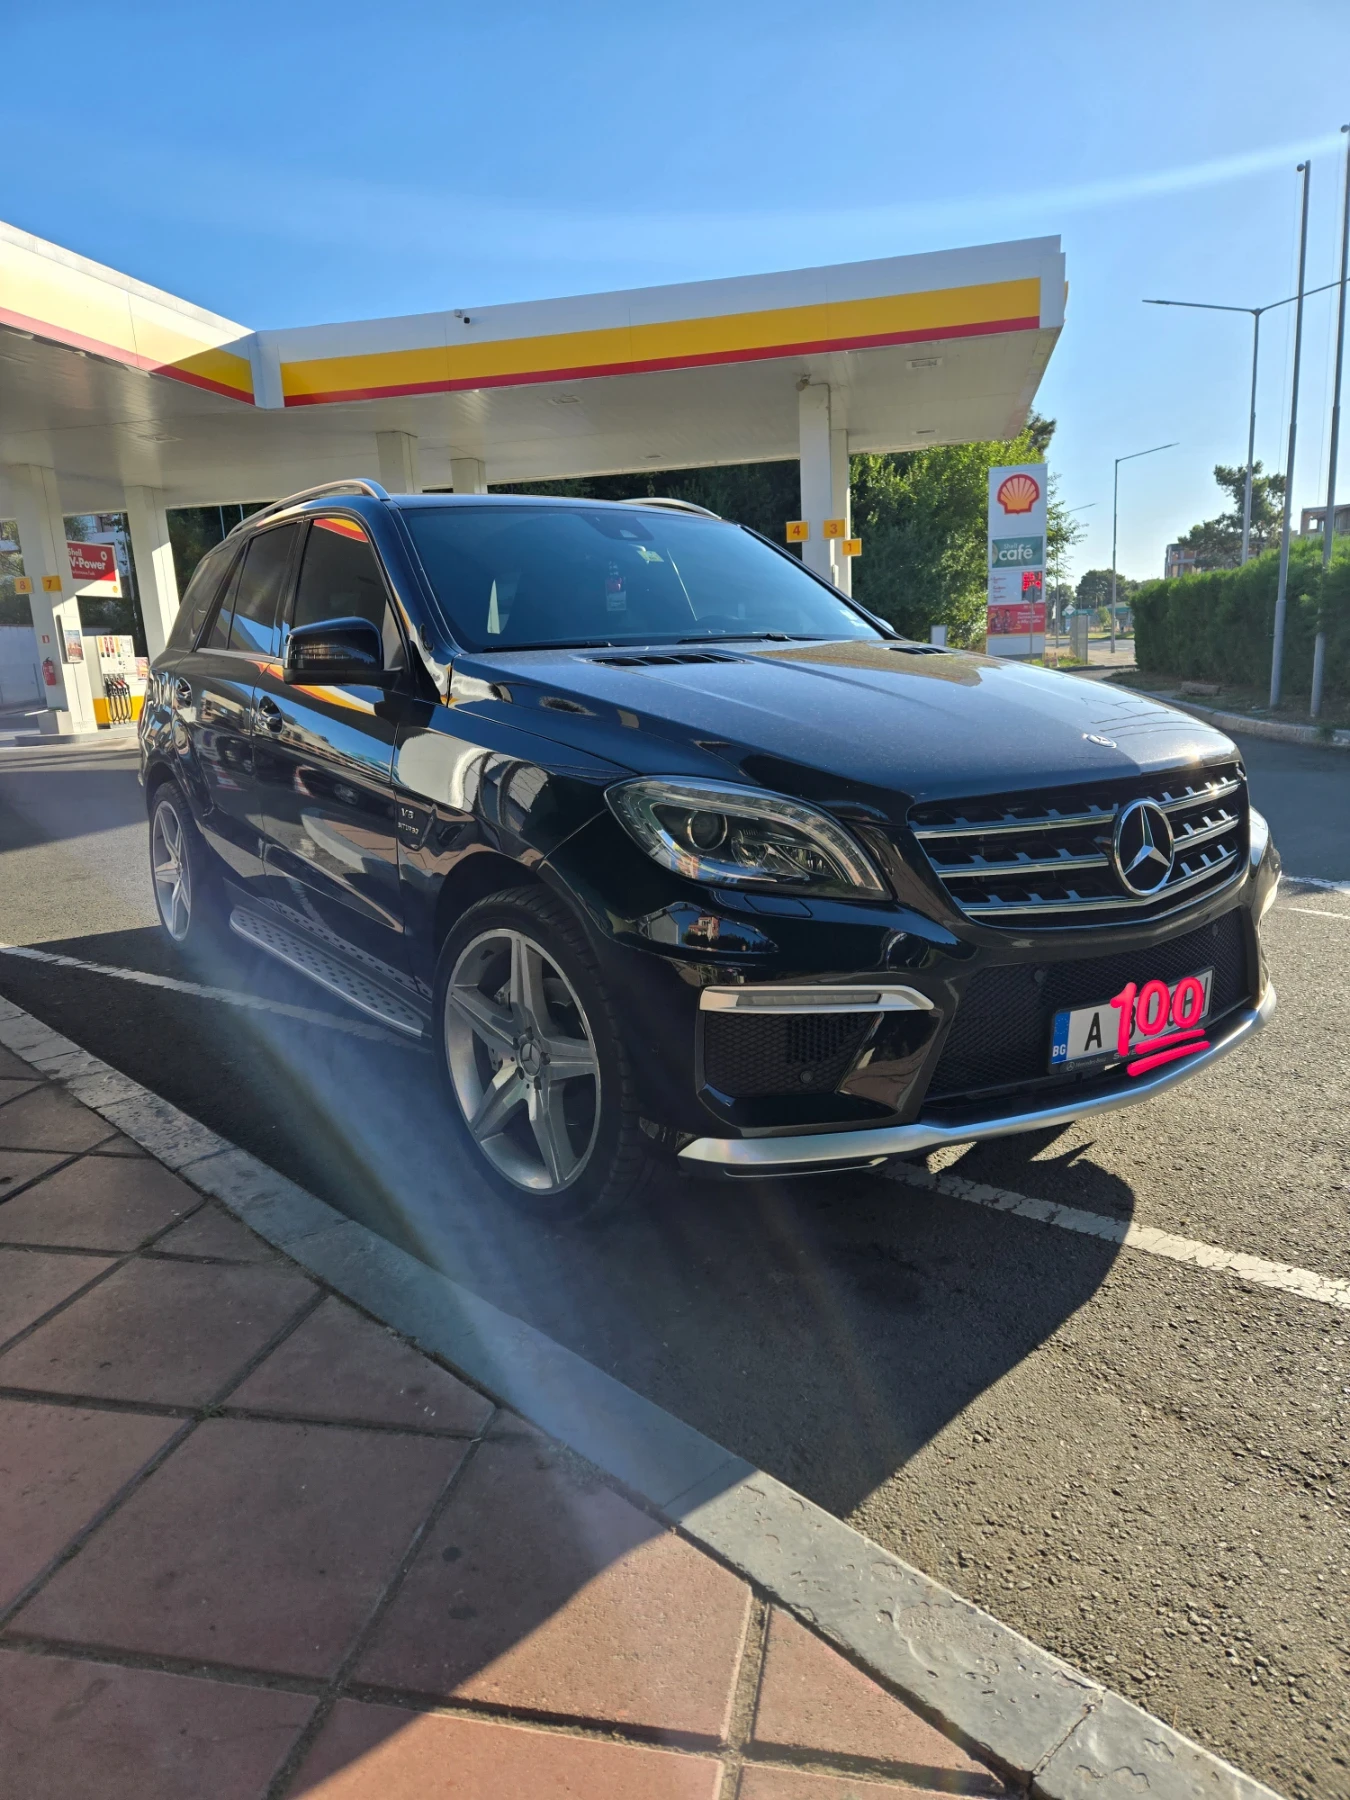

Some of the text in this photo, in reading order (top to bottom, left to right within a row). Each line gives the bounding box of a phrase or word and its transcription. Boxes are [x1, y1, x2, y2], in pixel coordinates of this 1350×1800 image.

[793, 525, 800, 535] 4
[830, 524, 837, 534] 3
[999, 544, 1033, 561] café
[70, 557, 105, 570] V-Power
[20, 580, 26, 590] 8
[46, 580, 52, 589] 7
[401, 808, 413, 818] V8
[1052, 1012, 1103, 1058] BG A
